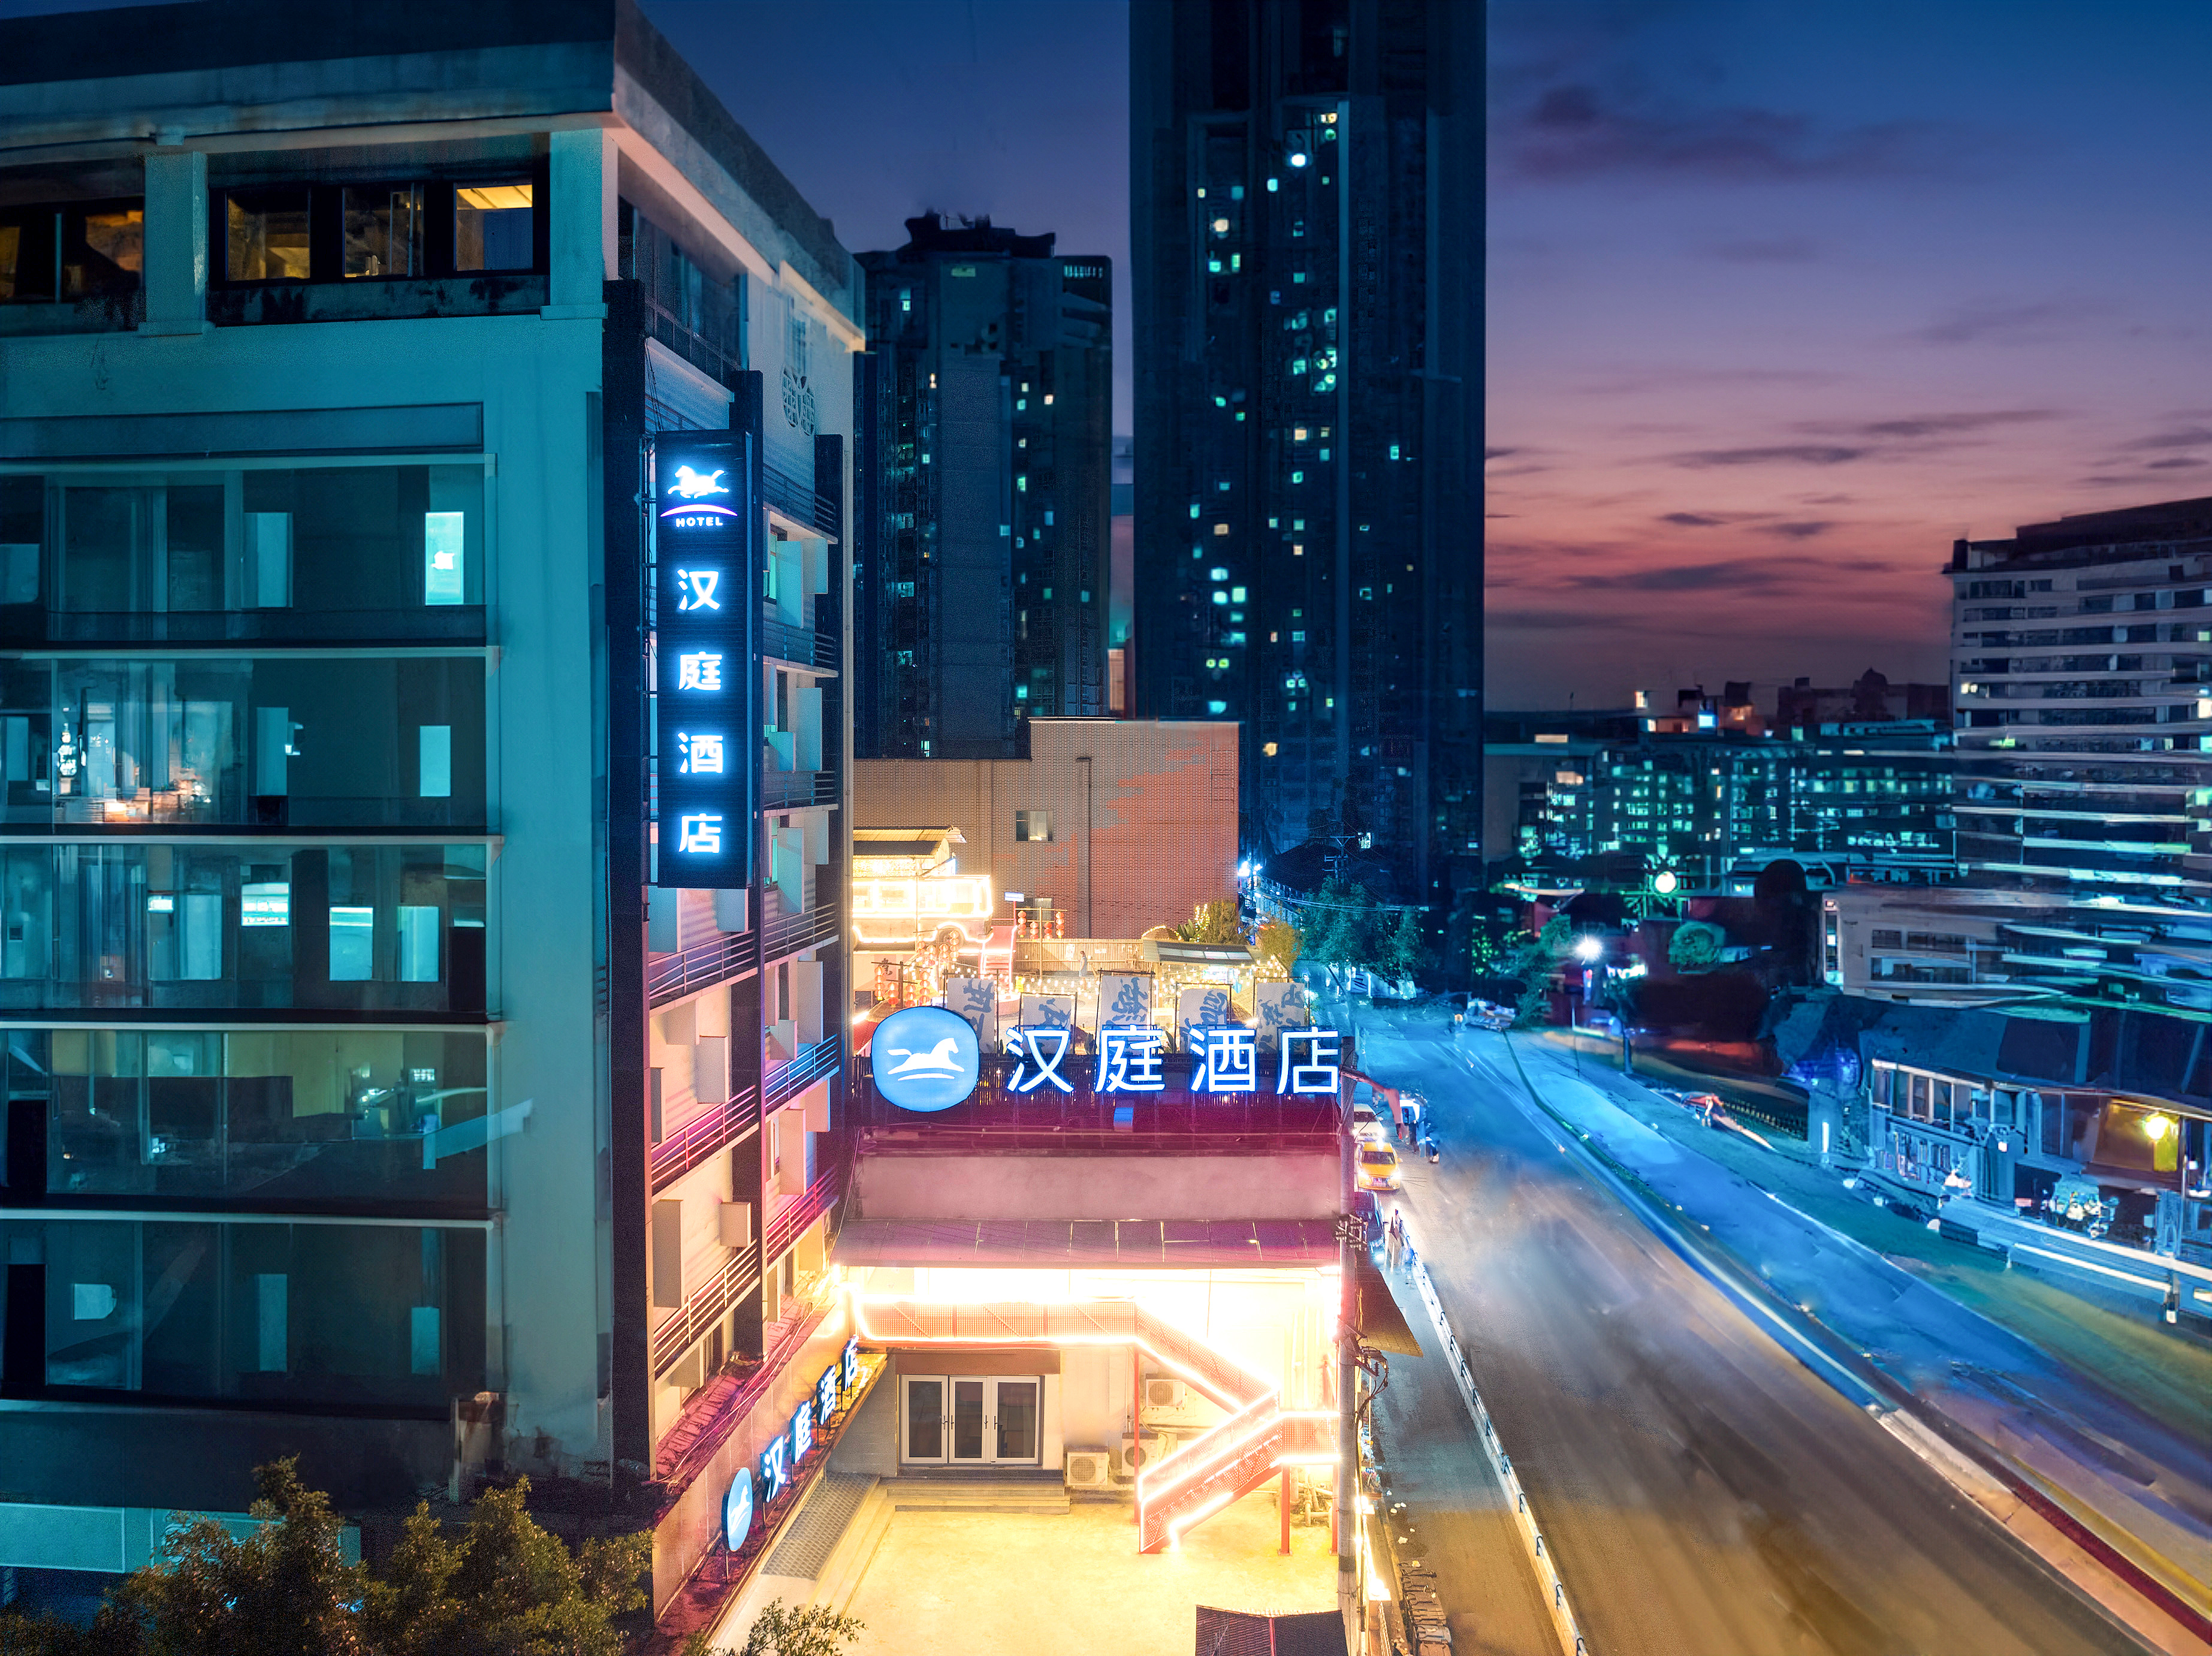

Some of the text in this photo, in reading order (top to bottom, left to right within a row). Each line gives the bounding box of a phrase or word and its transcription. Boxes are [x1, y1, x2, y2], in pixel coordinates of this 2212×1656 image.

[675, 517, 723, 527] HOTEL
[678, 569, 723, 854] 汉庭酒店
[1006, 1025, 1339, 1094] 汉庭酒店
[764, 1335, 859, 1503] 汉庭酒店
